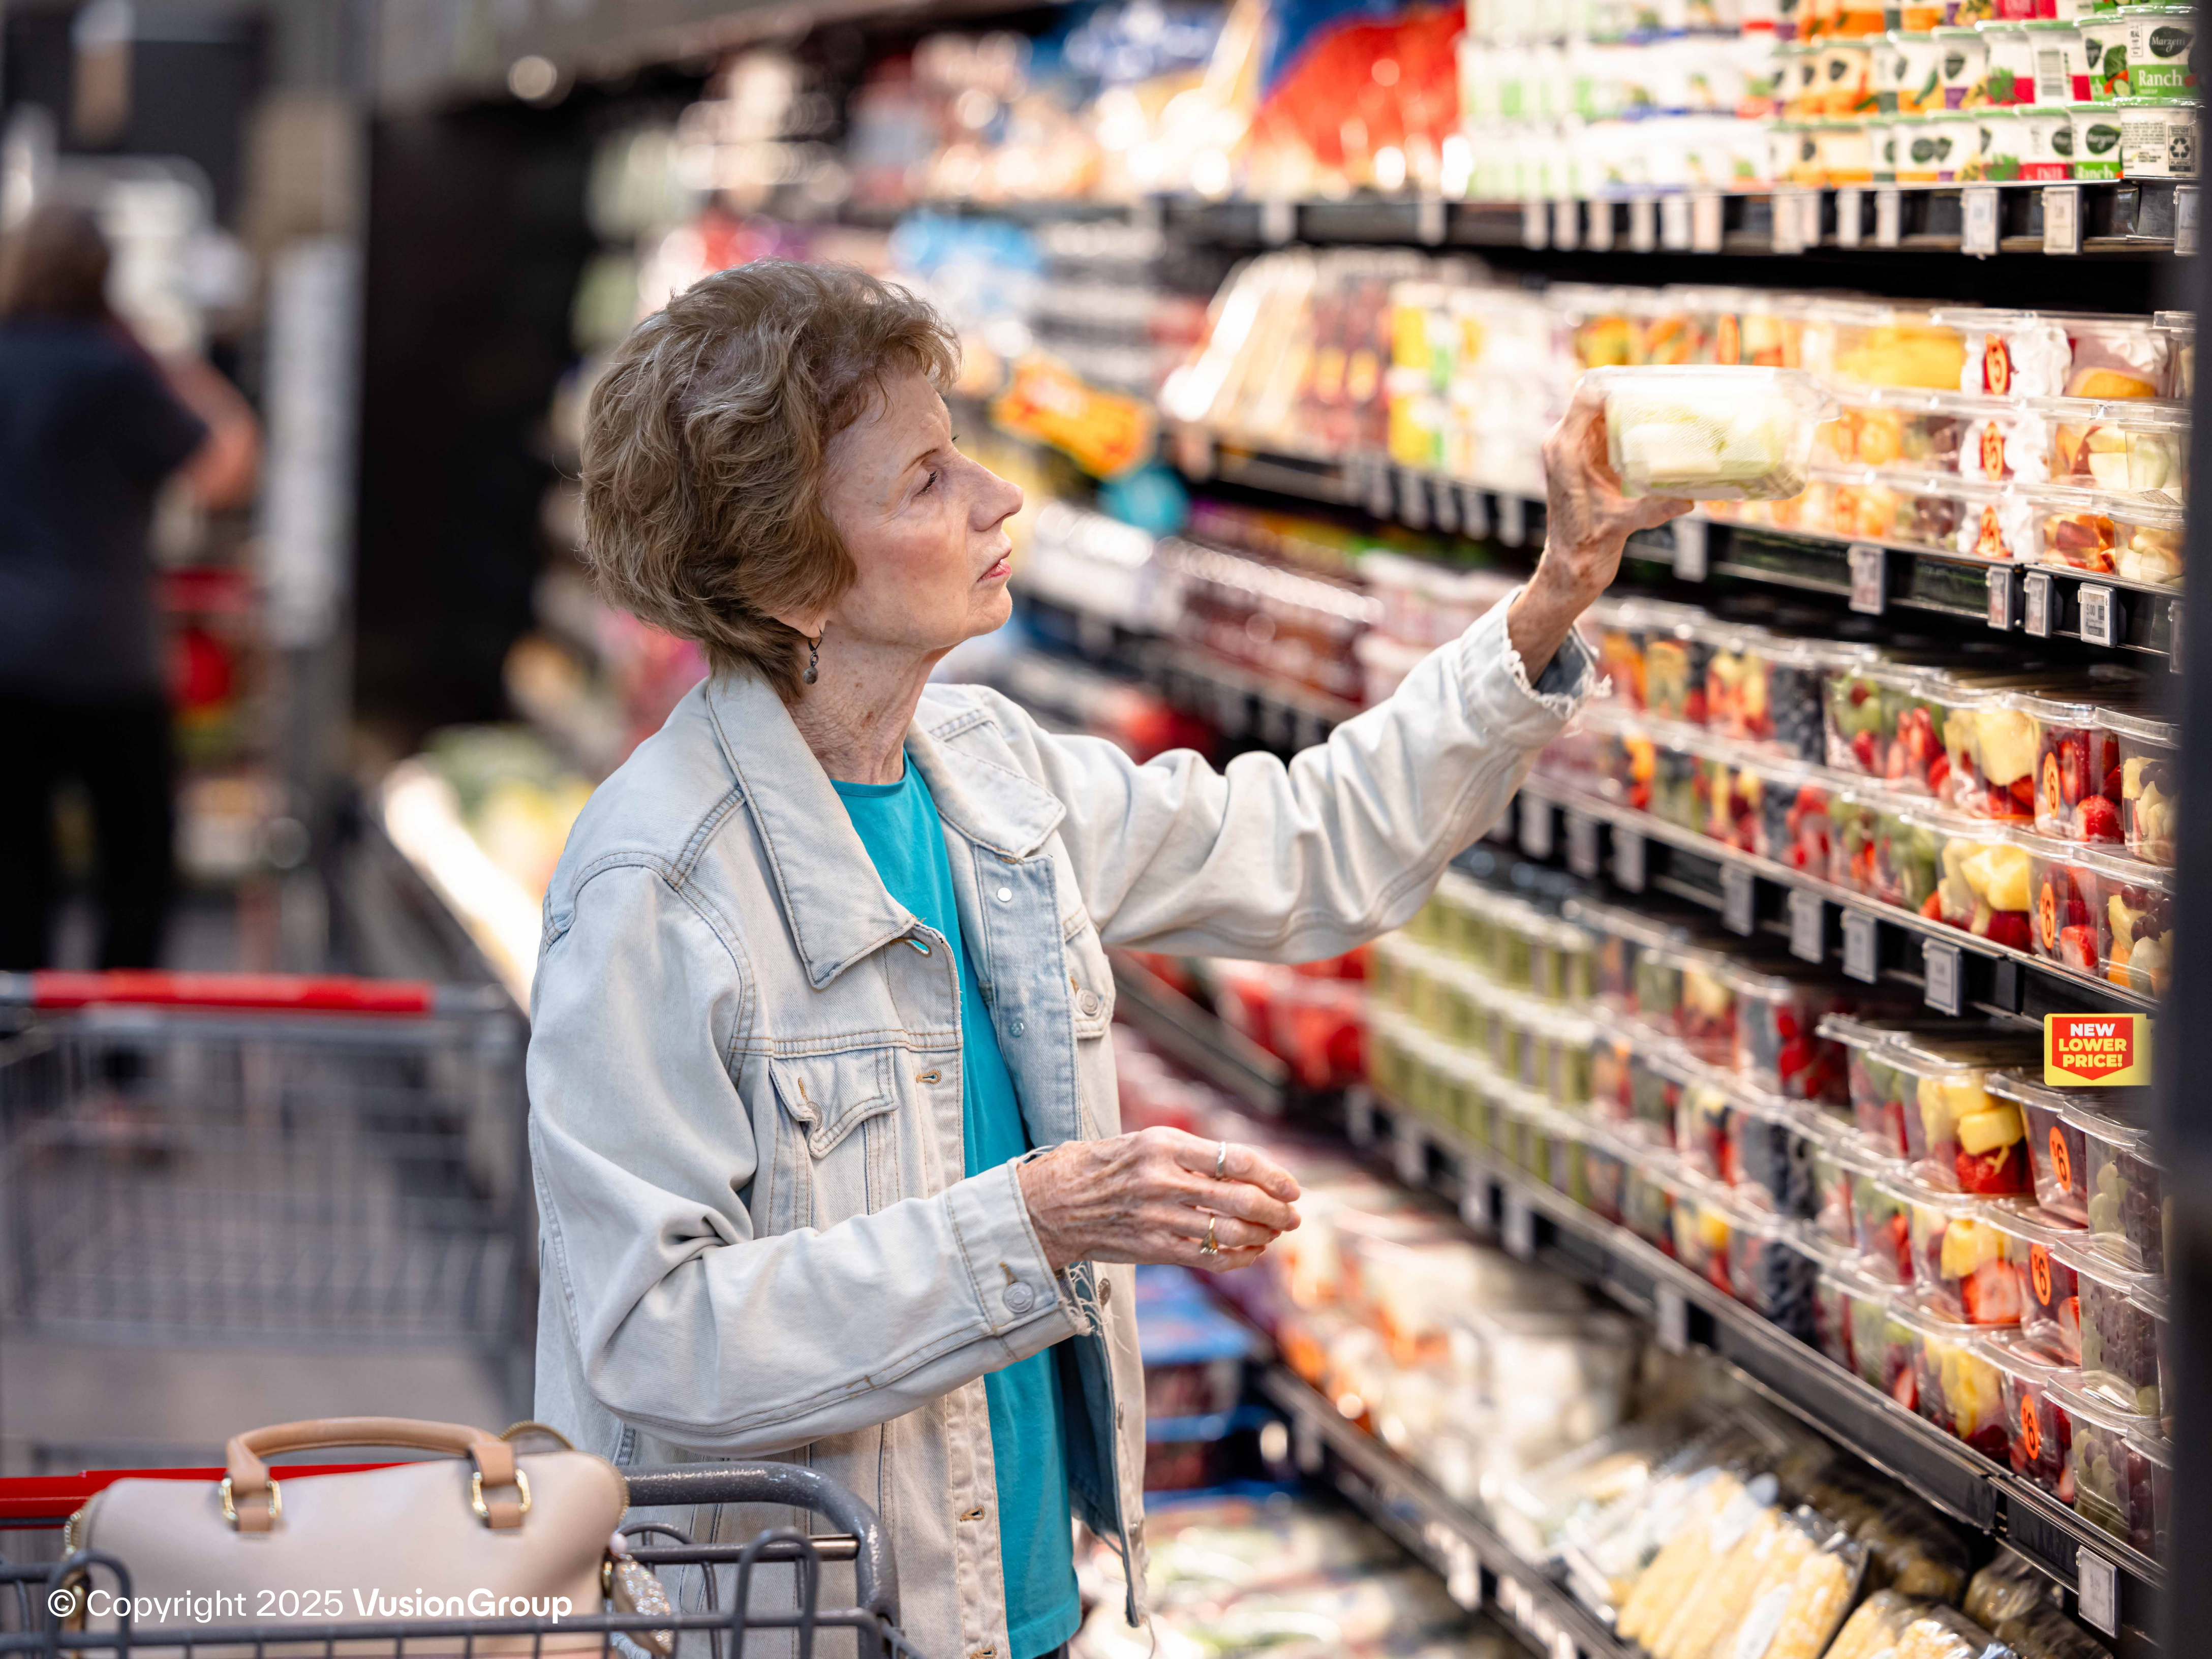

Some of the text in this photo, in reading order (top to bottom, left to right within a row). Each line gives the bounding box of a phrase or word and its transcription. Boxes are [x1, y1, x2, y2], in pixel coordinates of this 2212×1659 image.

[2152, 37, 2186, 53] Marzetti
[2138, 68, 2183, 86] Ranch
[2070, 1023, 2115, 1036] NEW
[2059, 1038, 2127, 1052] LOWER
[2063, 1054, 2123, 1067] PRICE!
